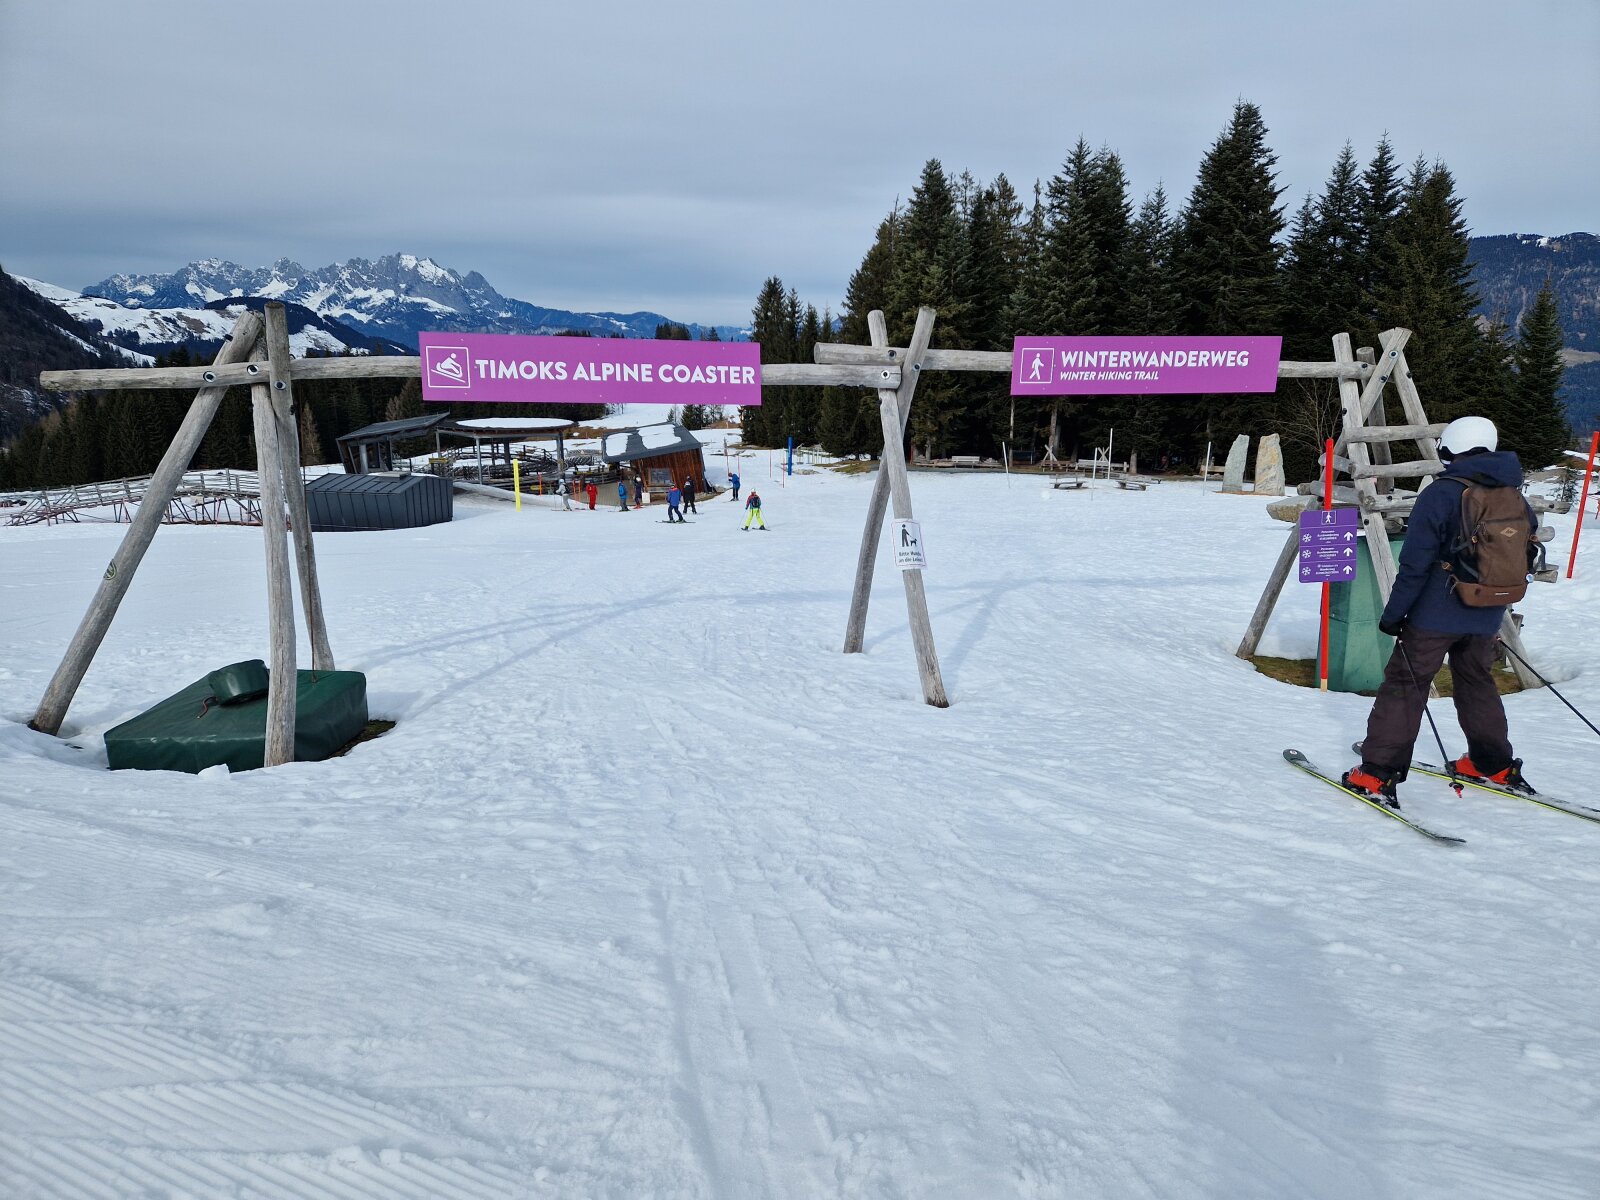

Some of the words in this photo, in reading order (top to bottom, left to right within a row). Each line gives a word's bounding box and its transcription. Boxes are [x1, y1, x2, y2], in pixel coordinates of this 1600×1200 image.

[1061, 351, 1250, 367] WINTERWANDERWEG
[476, 360, 568, 380] TIMOKS
[573, 362, 653, 382] ALPINE
[659, 364, 755, 385] COASTER
[1059, 371, 1096, 381] WINTER
[1097, 371, 1133, 381] HIKING
[1134, 371, 1159, 380] TRAIL
